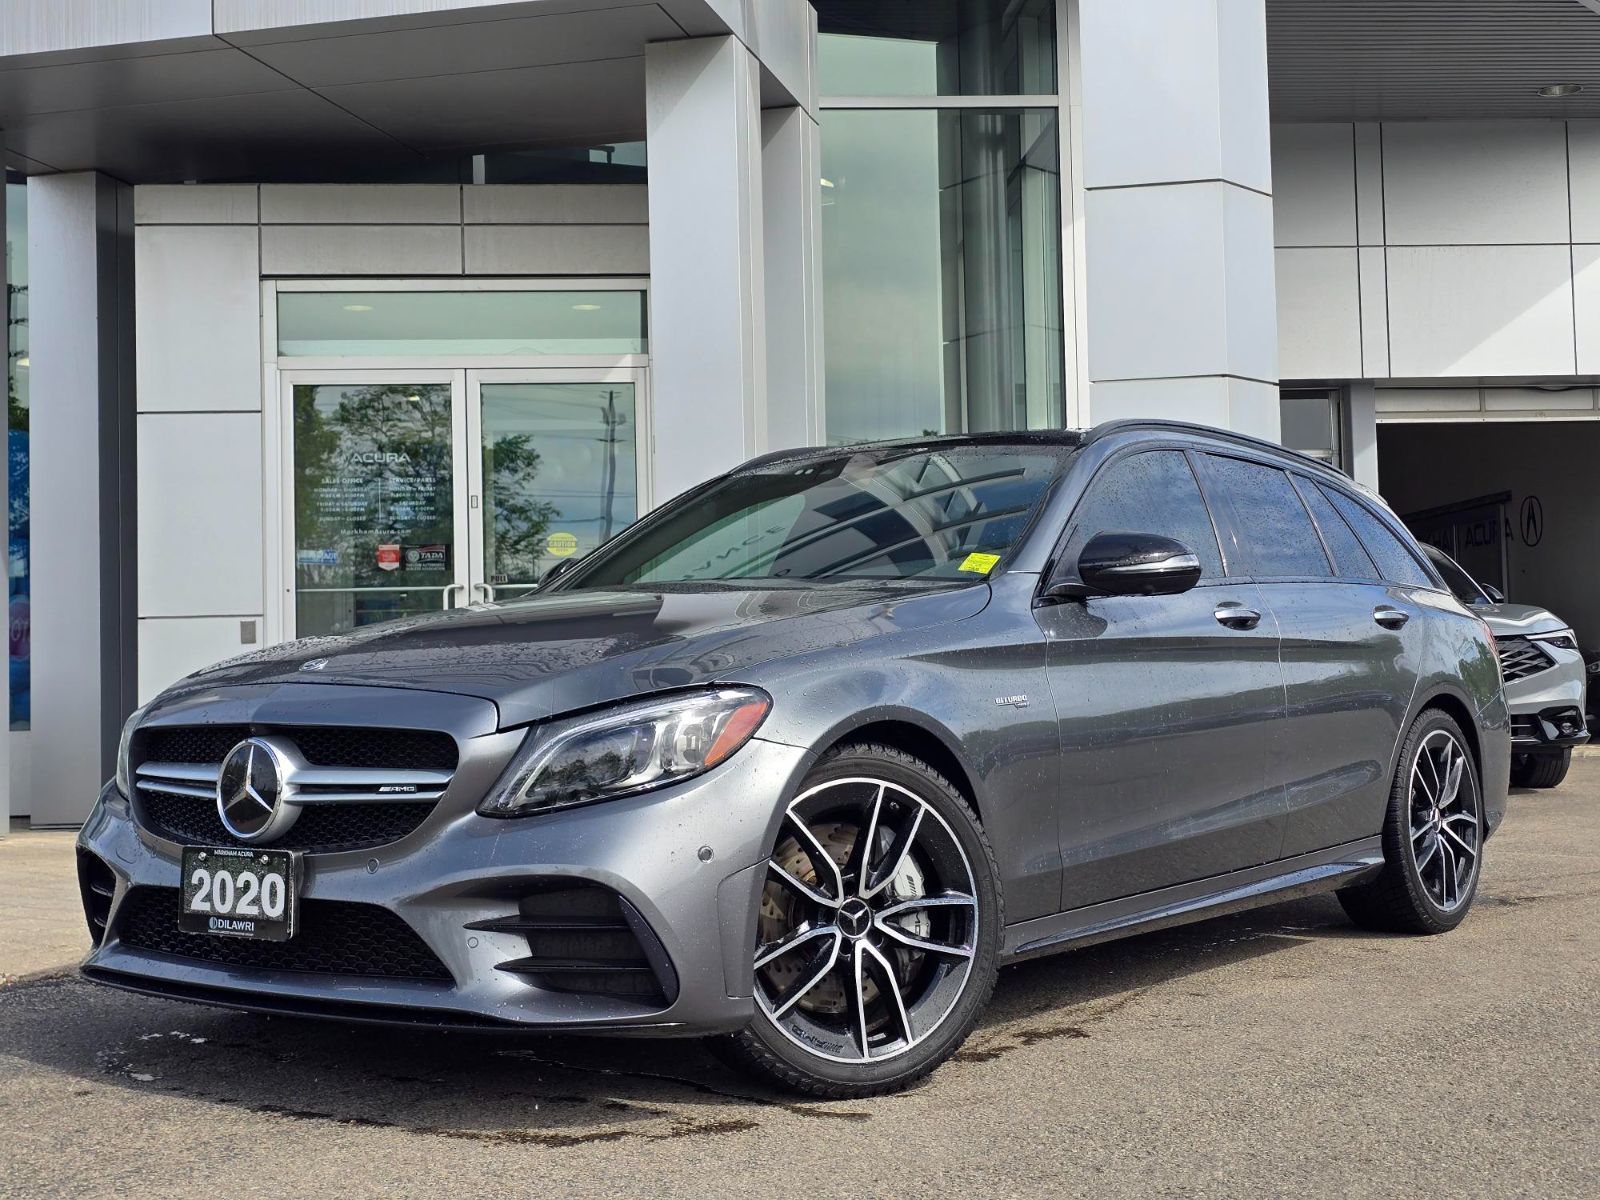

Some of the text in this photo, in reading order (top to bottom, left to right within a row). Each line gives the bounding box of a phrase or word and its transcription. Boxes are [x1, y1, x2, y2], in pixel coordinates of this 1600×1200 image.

[352, 453, 412, 463] ACURA
[190, 868, 286, 918] 2020
[217, 918, 255, 932] DILAWRI
